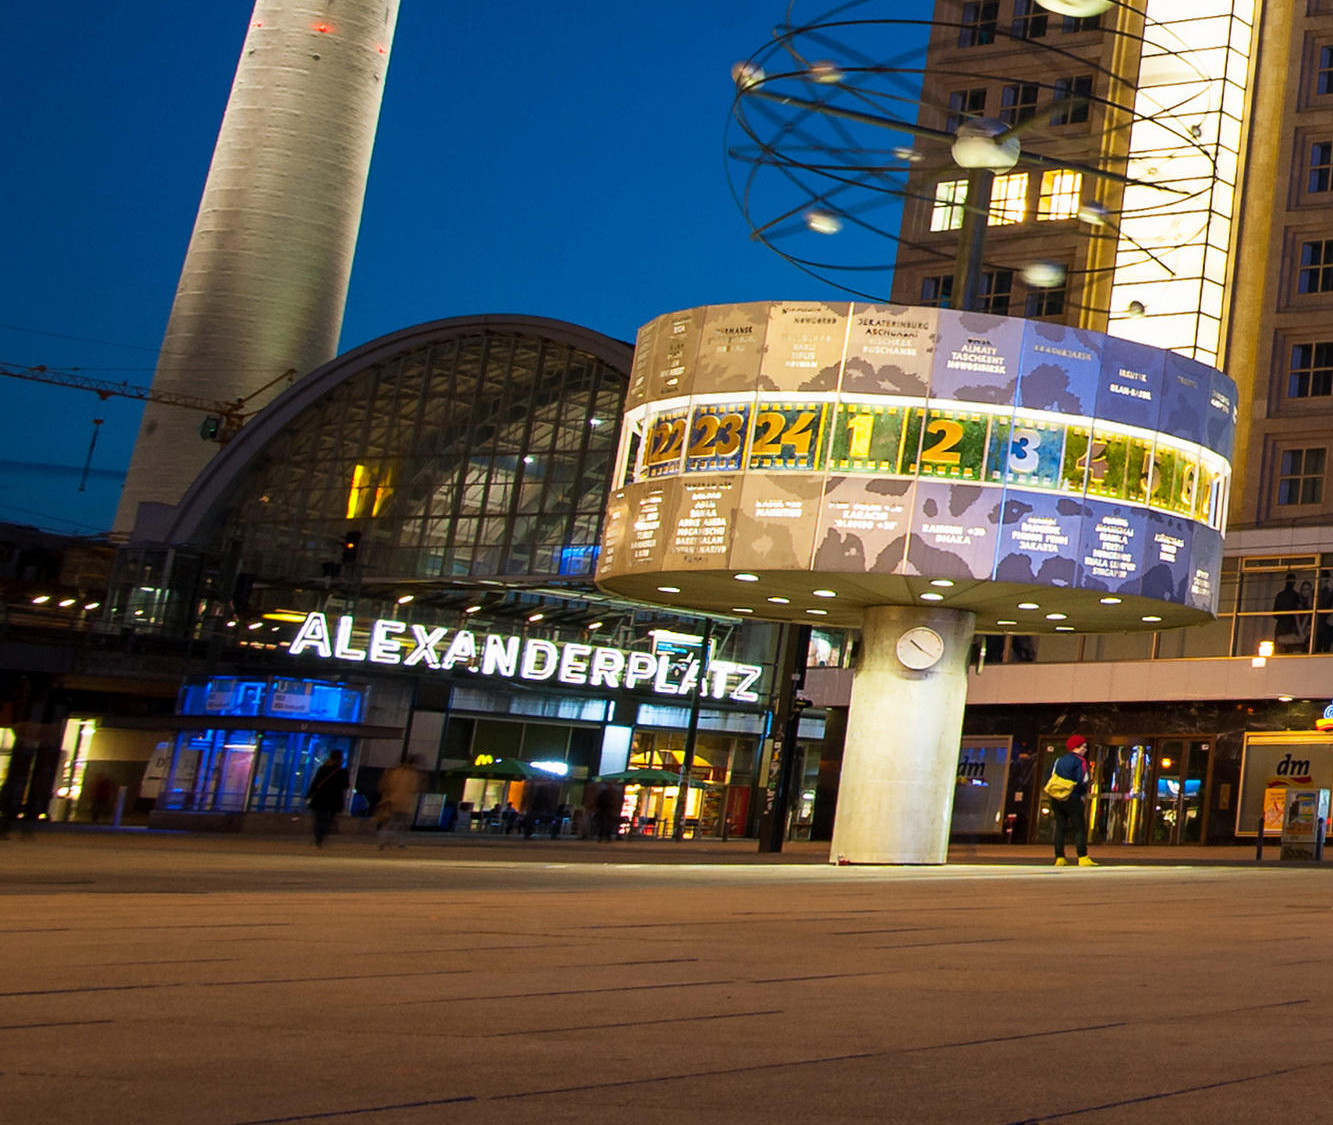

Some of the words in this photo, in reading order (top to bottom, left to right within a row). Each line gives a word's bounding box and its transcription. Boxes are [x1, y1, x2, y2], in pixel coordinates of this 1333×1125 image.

[951, 351, 1005, 365] TASCHKENT
[961, 344, 998, 355] ALMATY
[649, 416, 688, 465] 22
[689, 413, 744, 457] 23
[751, 412, 816, 457] 24
[846, 414, 875, 458] 1
[921, 419, 964, 465] 2
[1008, 428, 1042, 473] 3
[841, 510, 889, 520] KARACHI
[935, 534, 971, 545] DHAKA
[1018, 541, 1059, 553] JAKARTA
[288, 611, 764, 704] ALEXANDERPLATZ
[1277, 753, 1311, 776] dm
